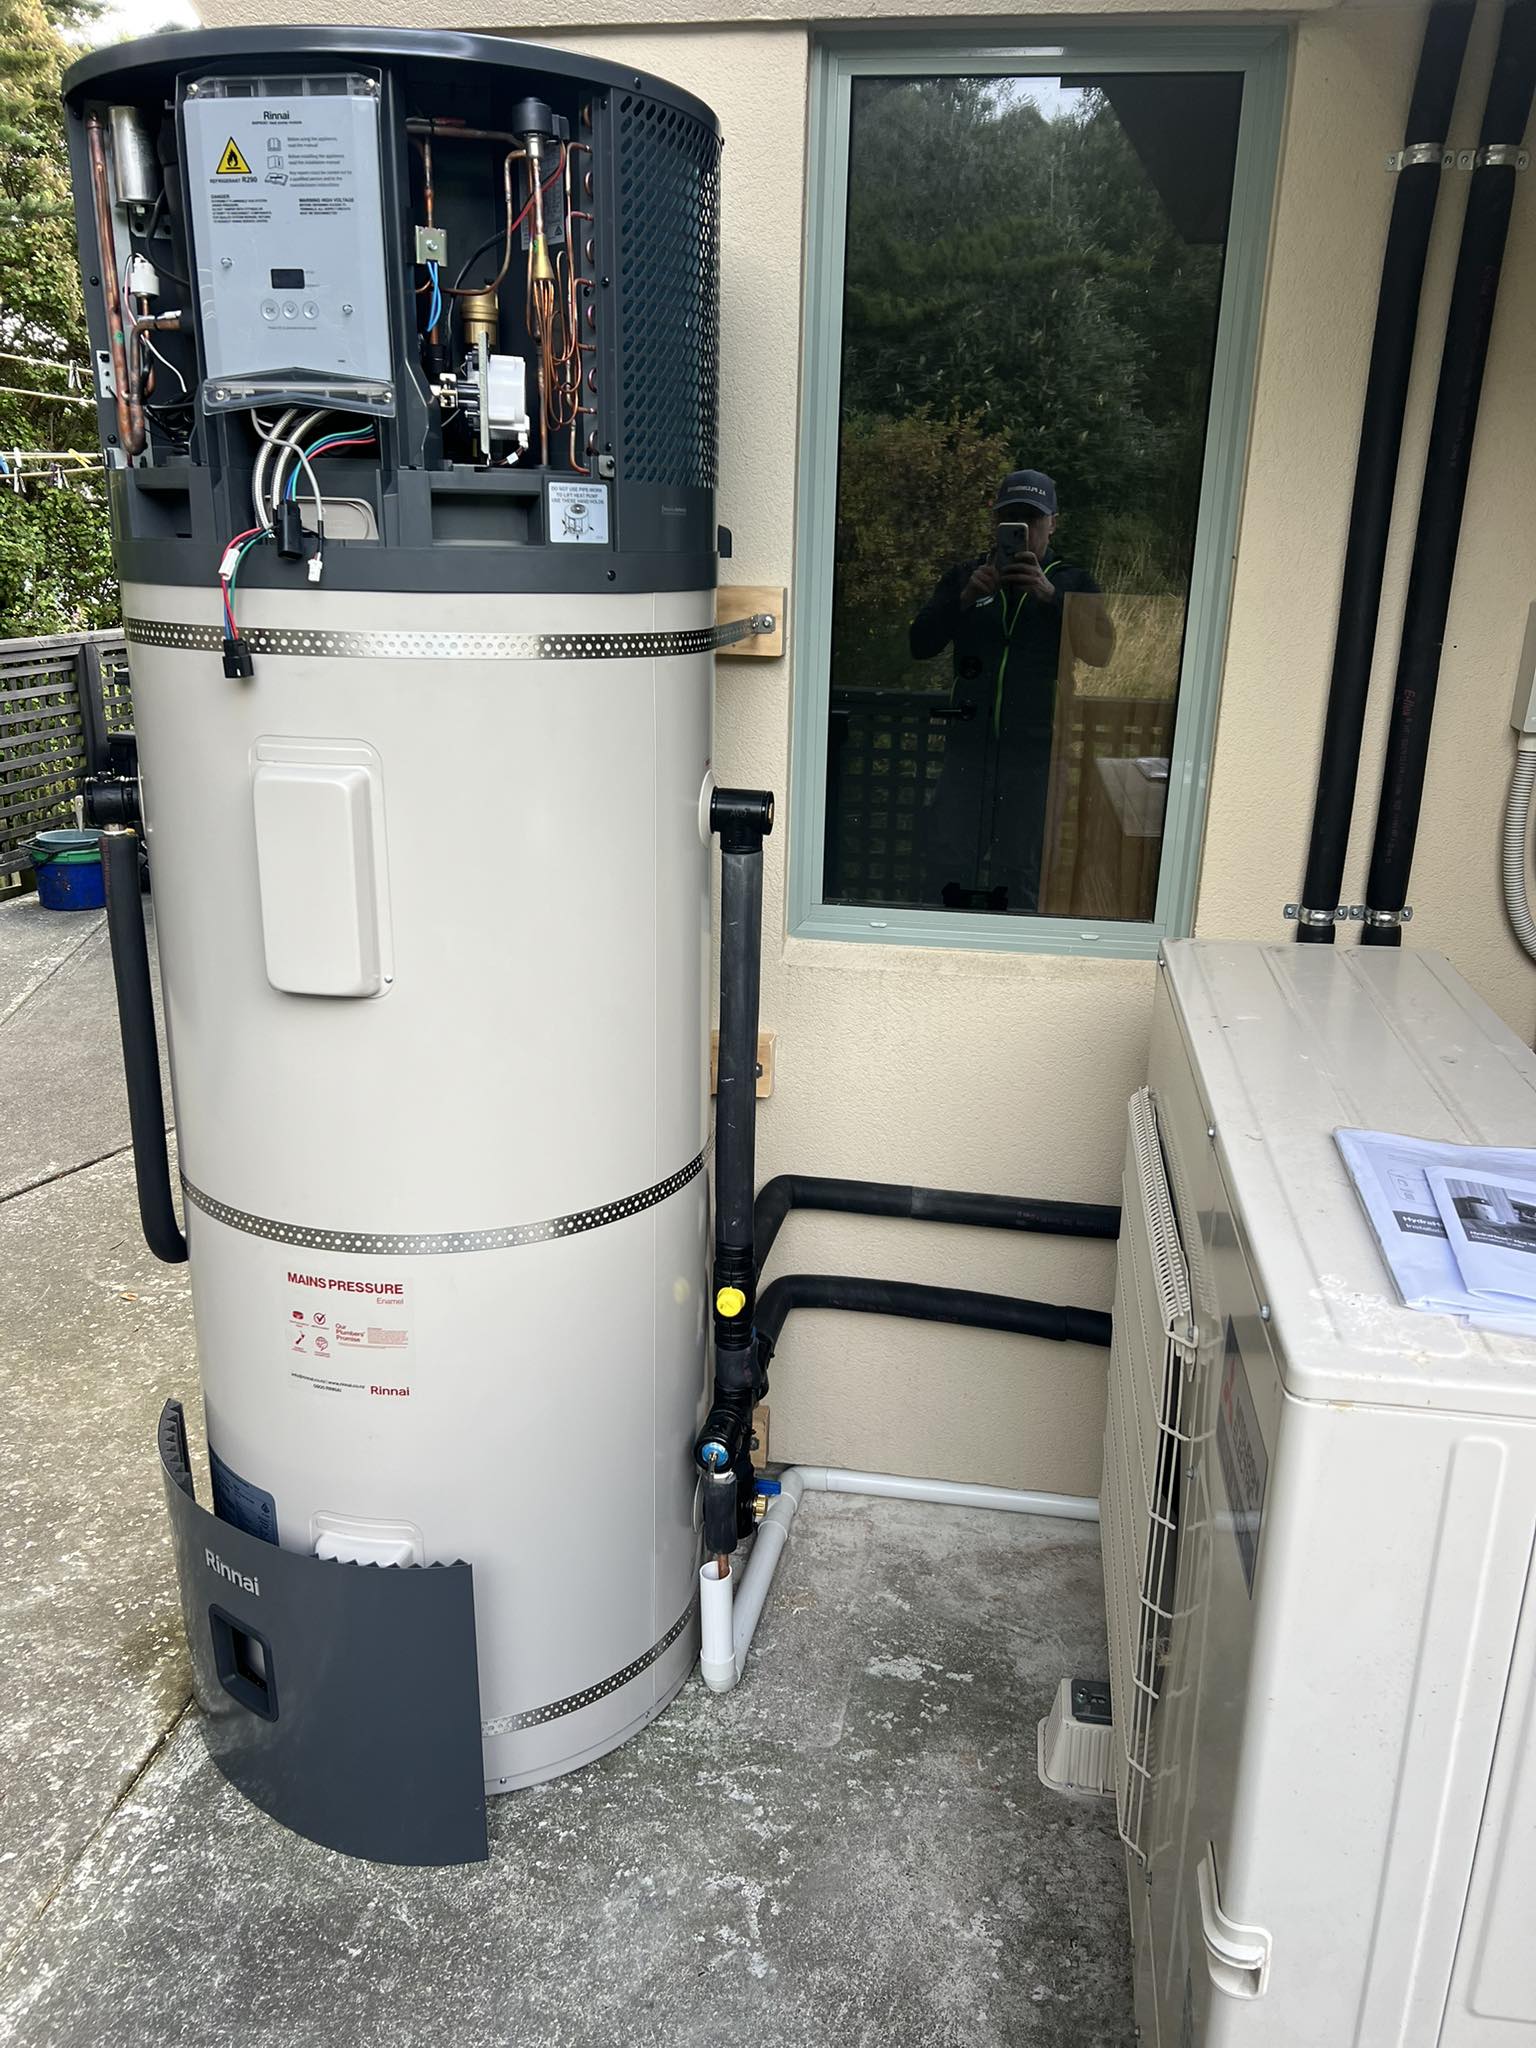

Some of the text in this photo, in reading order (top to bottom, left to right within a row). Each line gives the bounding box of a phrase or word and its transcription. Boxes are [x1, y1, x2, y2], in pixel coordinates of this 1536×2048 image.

[263, 111, 290, 120] Rinnai
[287, 1272, 404, 1295] MAINS PRESSURE
[376, 1297, 404, 1305] Enamel
[370, 1385, 410, 1396] Rinnai
[205, 1548, 260, 1596] Rinnai
